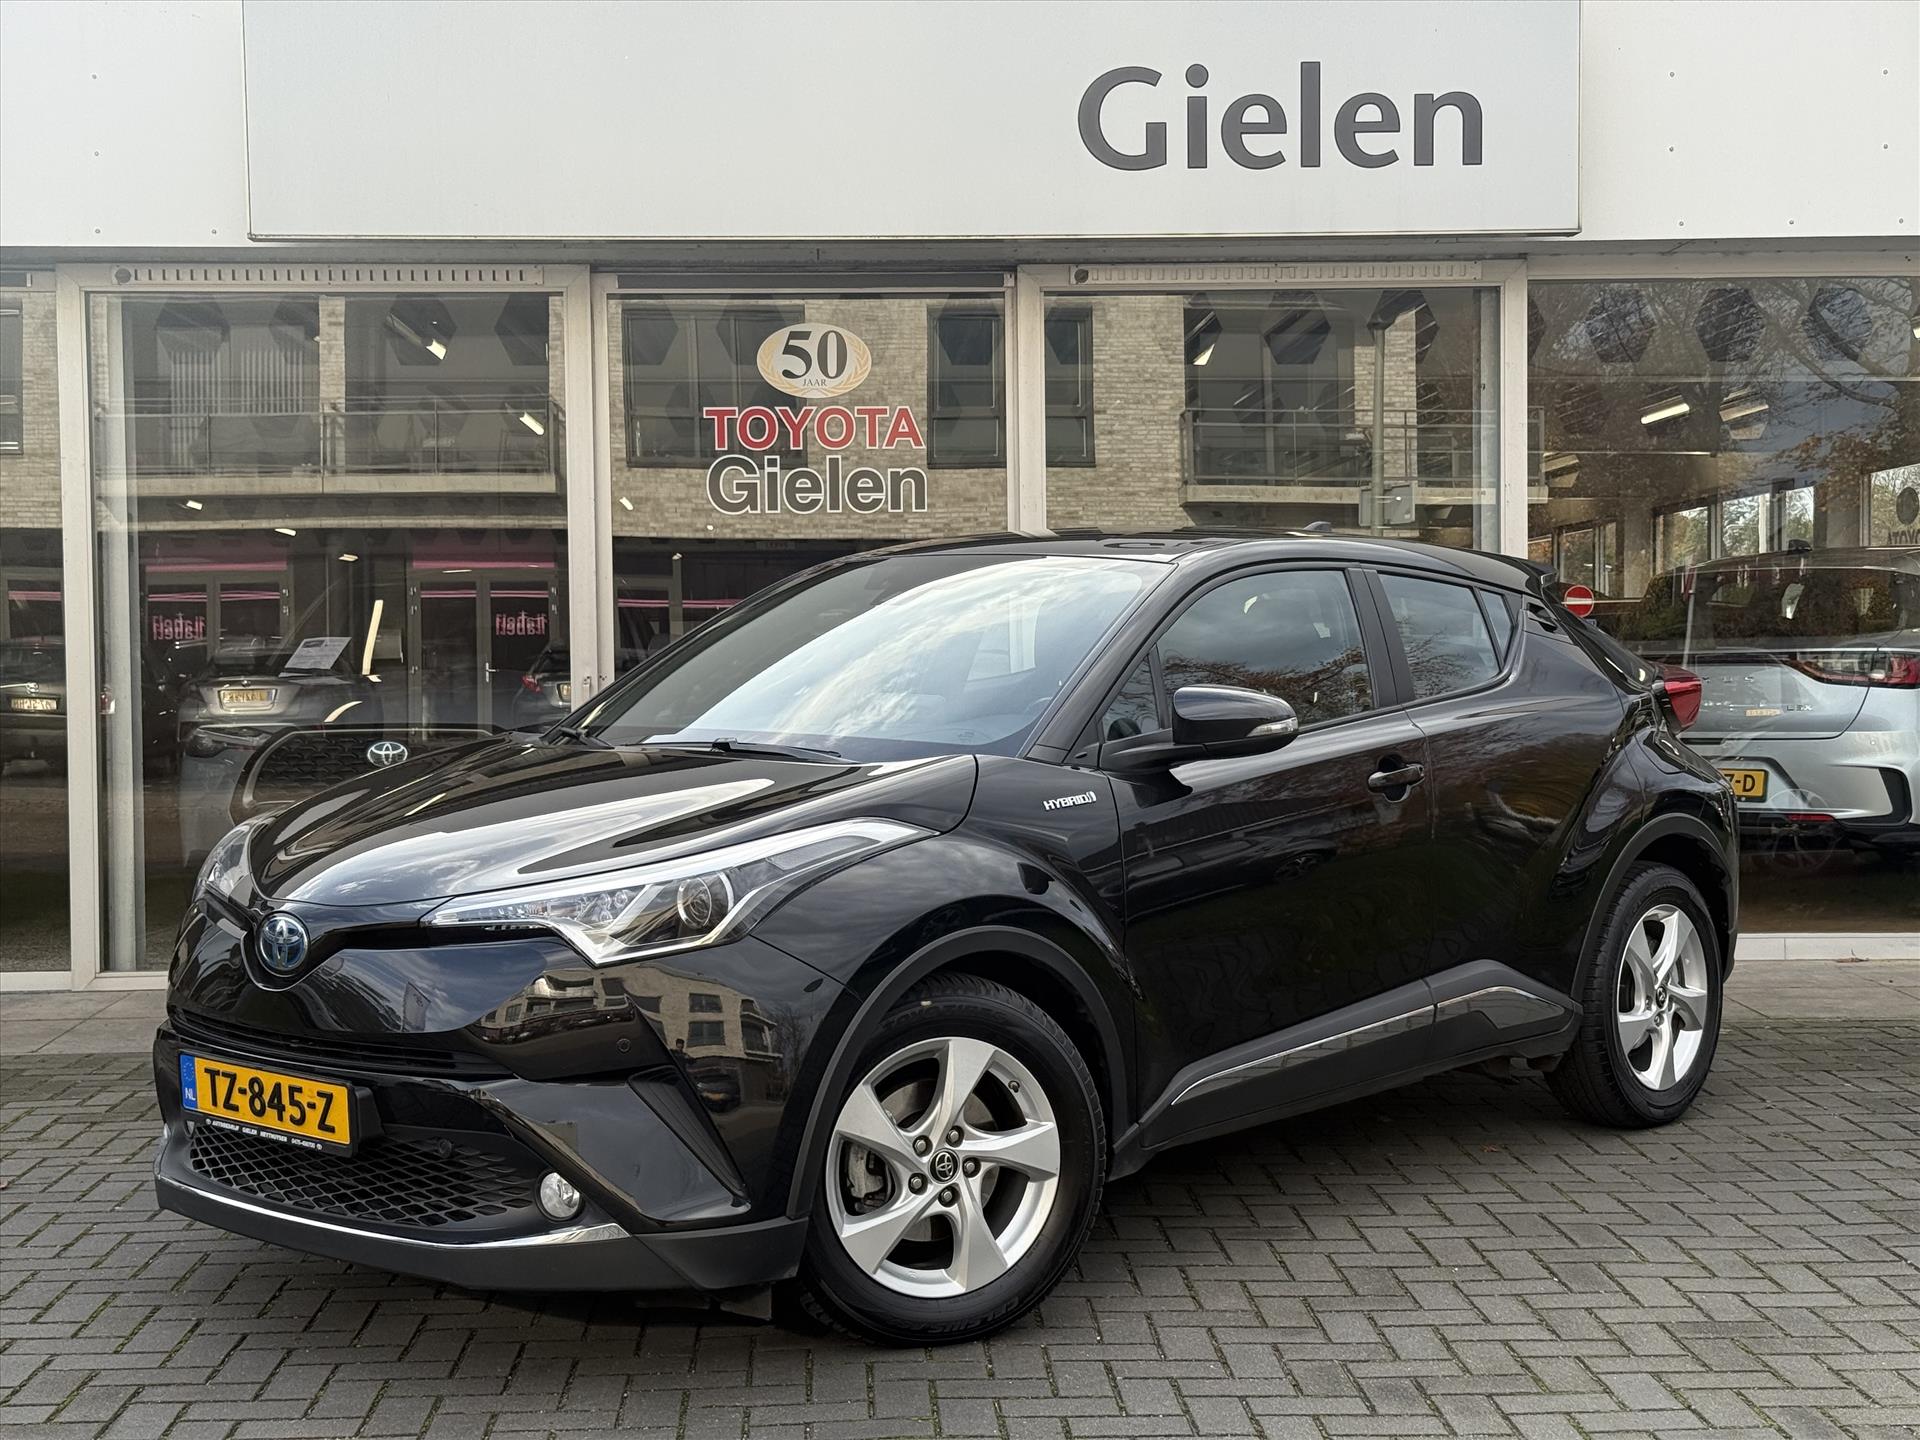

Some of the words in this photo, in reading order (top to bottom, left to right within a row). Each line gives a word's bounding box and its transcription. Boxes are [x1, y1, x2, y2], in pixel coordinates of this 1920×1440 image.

[1078, 61, 1483, 171] Gielen
[781, 329, 848, 380] 50
[802, 378, 828, 388] JAAR
[703, 405, 926, 451] TOYOTA
[706, 454, 928, 515] Gielen
[1043, 793, 1090, 810] HYBRID
[185, 1087, 196, 1101] NL
[204, 1067, 336, 1133] TZ-845-Z
